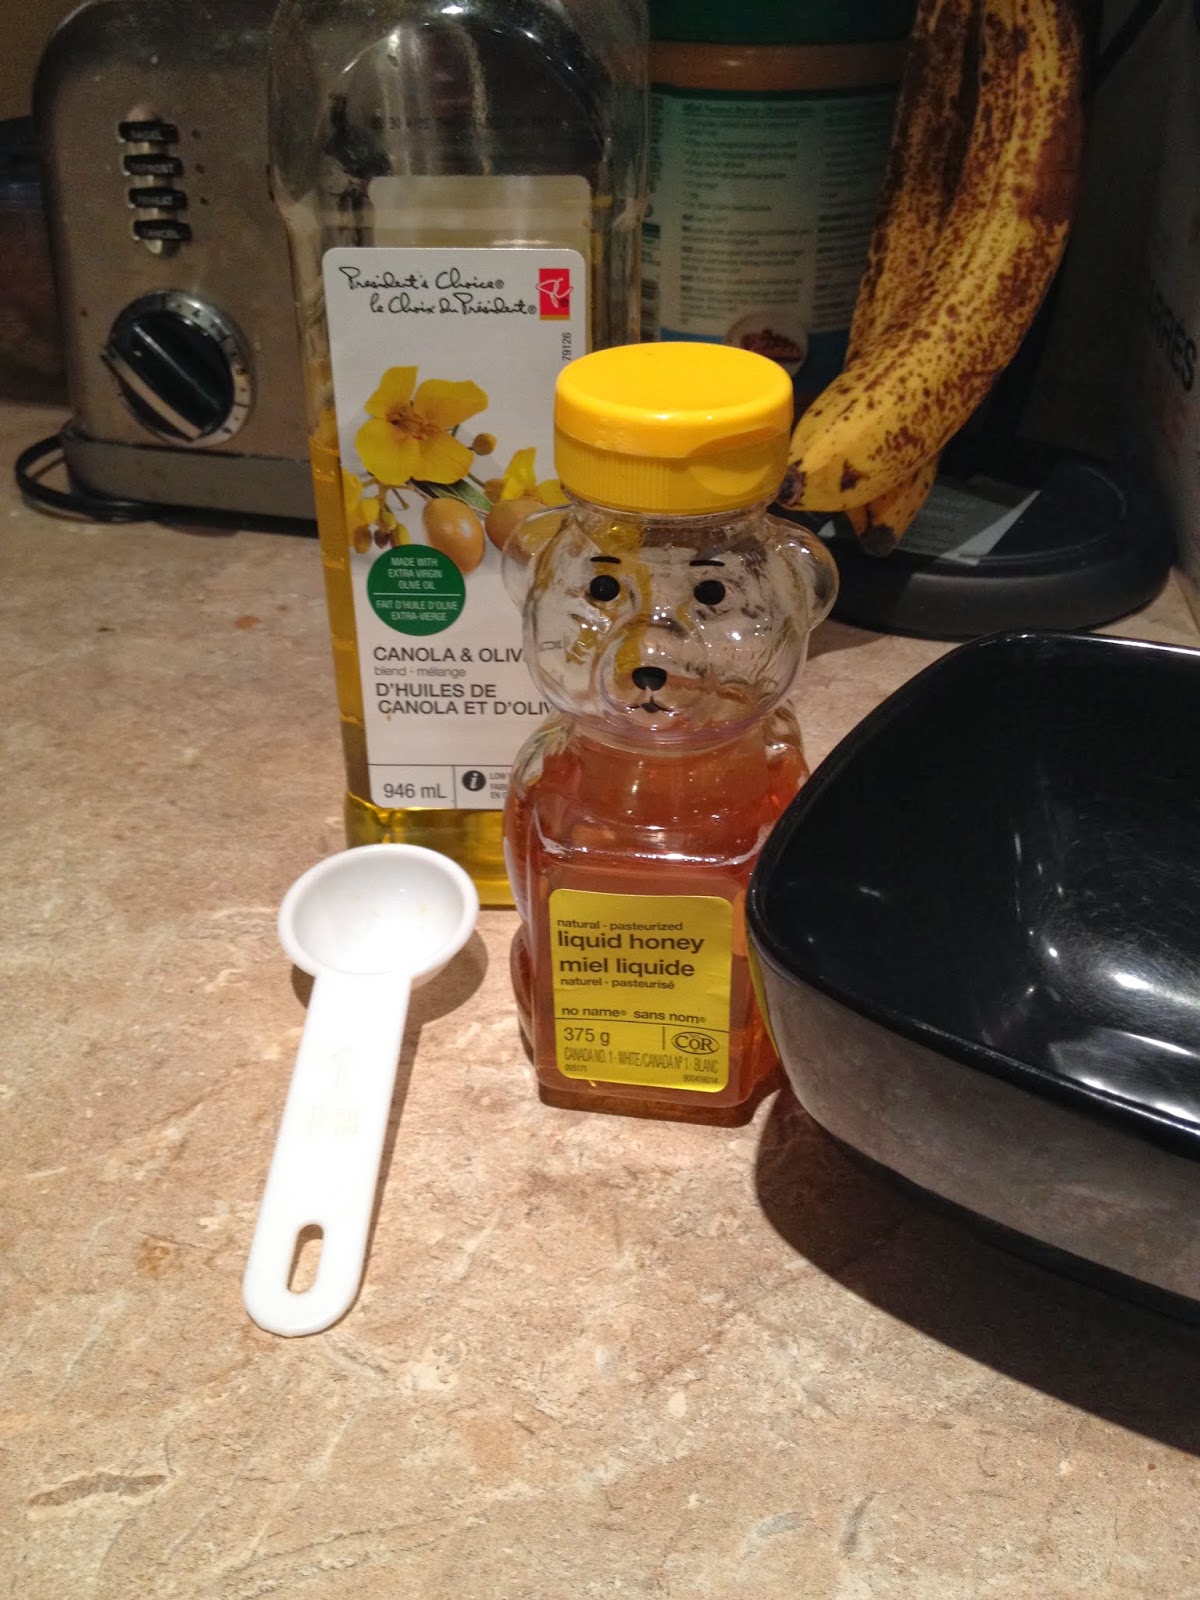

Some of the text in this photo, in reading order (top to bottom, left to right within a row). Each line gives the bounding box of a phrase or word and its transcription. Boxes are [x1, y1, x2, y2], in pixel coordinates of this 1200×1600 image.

[339, 266, 429, 291] President's
[388, 292, 435, 314] Choix
[562, 332, 572, 361] 79126
[391, 557, 438, 566] MADE WITH
[388, 568, 442, 578] EXTRA VIRGIN
[398, 580, 436, 590] OLIVE OIL
[376, 600, 458, 610] FAIT D'HUILE D'OLIVE
[373, 646, 523, 663] CANOLA & OLIV
[374, 666, 407, 676] blend
[417, 666, 466, 679] mélange
[376, 683, 497, 698] D'HUILES DE
[378, 700, 552, 716] CANOLA ET D'OLIV
[383, 783, 416, 798] 946
[421, 784, 447, 798] mL
[557, 919, 600, 929] natural
[610, 922, 683, 932] pasteurized
[557, 930, 704, 954] liquid honey
[560, 957, 695, 978] miel liquide
[560, 977, 603, 986] naturel
[611, 978, 675, 990] pasteurisé
[562, 1008, 579, 1016] no
[633, 1010, 665, 1020] sans
[563, 1027, 610, 1046] 375 g
[564, 1046, 592, 1062] CANADA
[694, 1057, 719, 1073] BLANC
